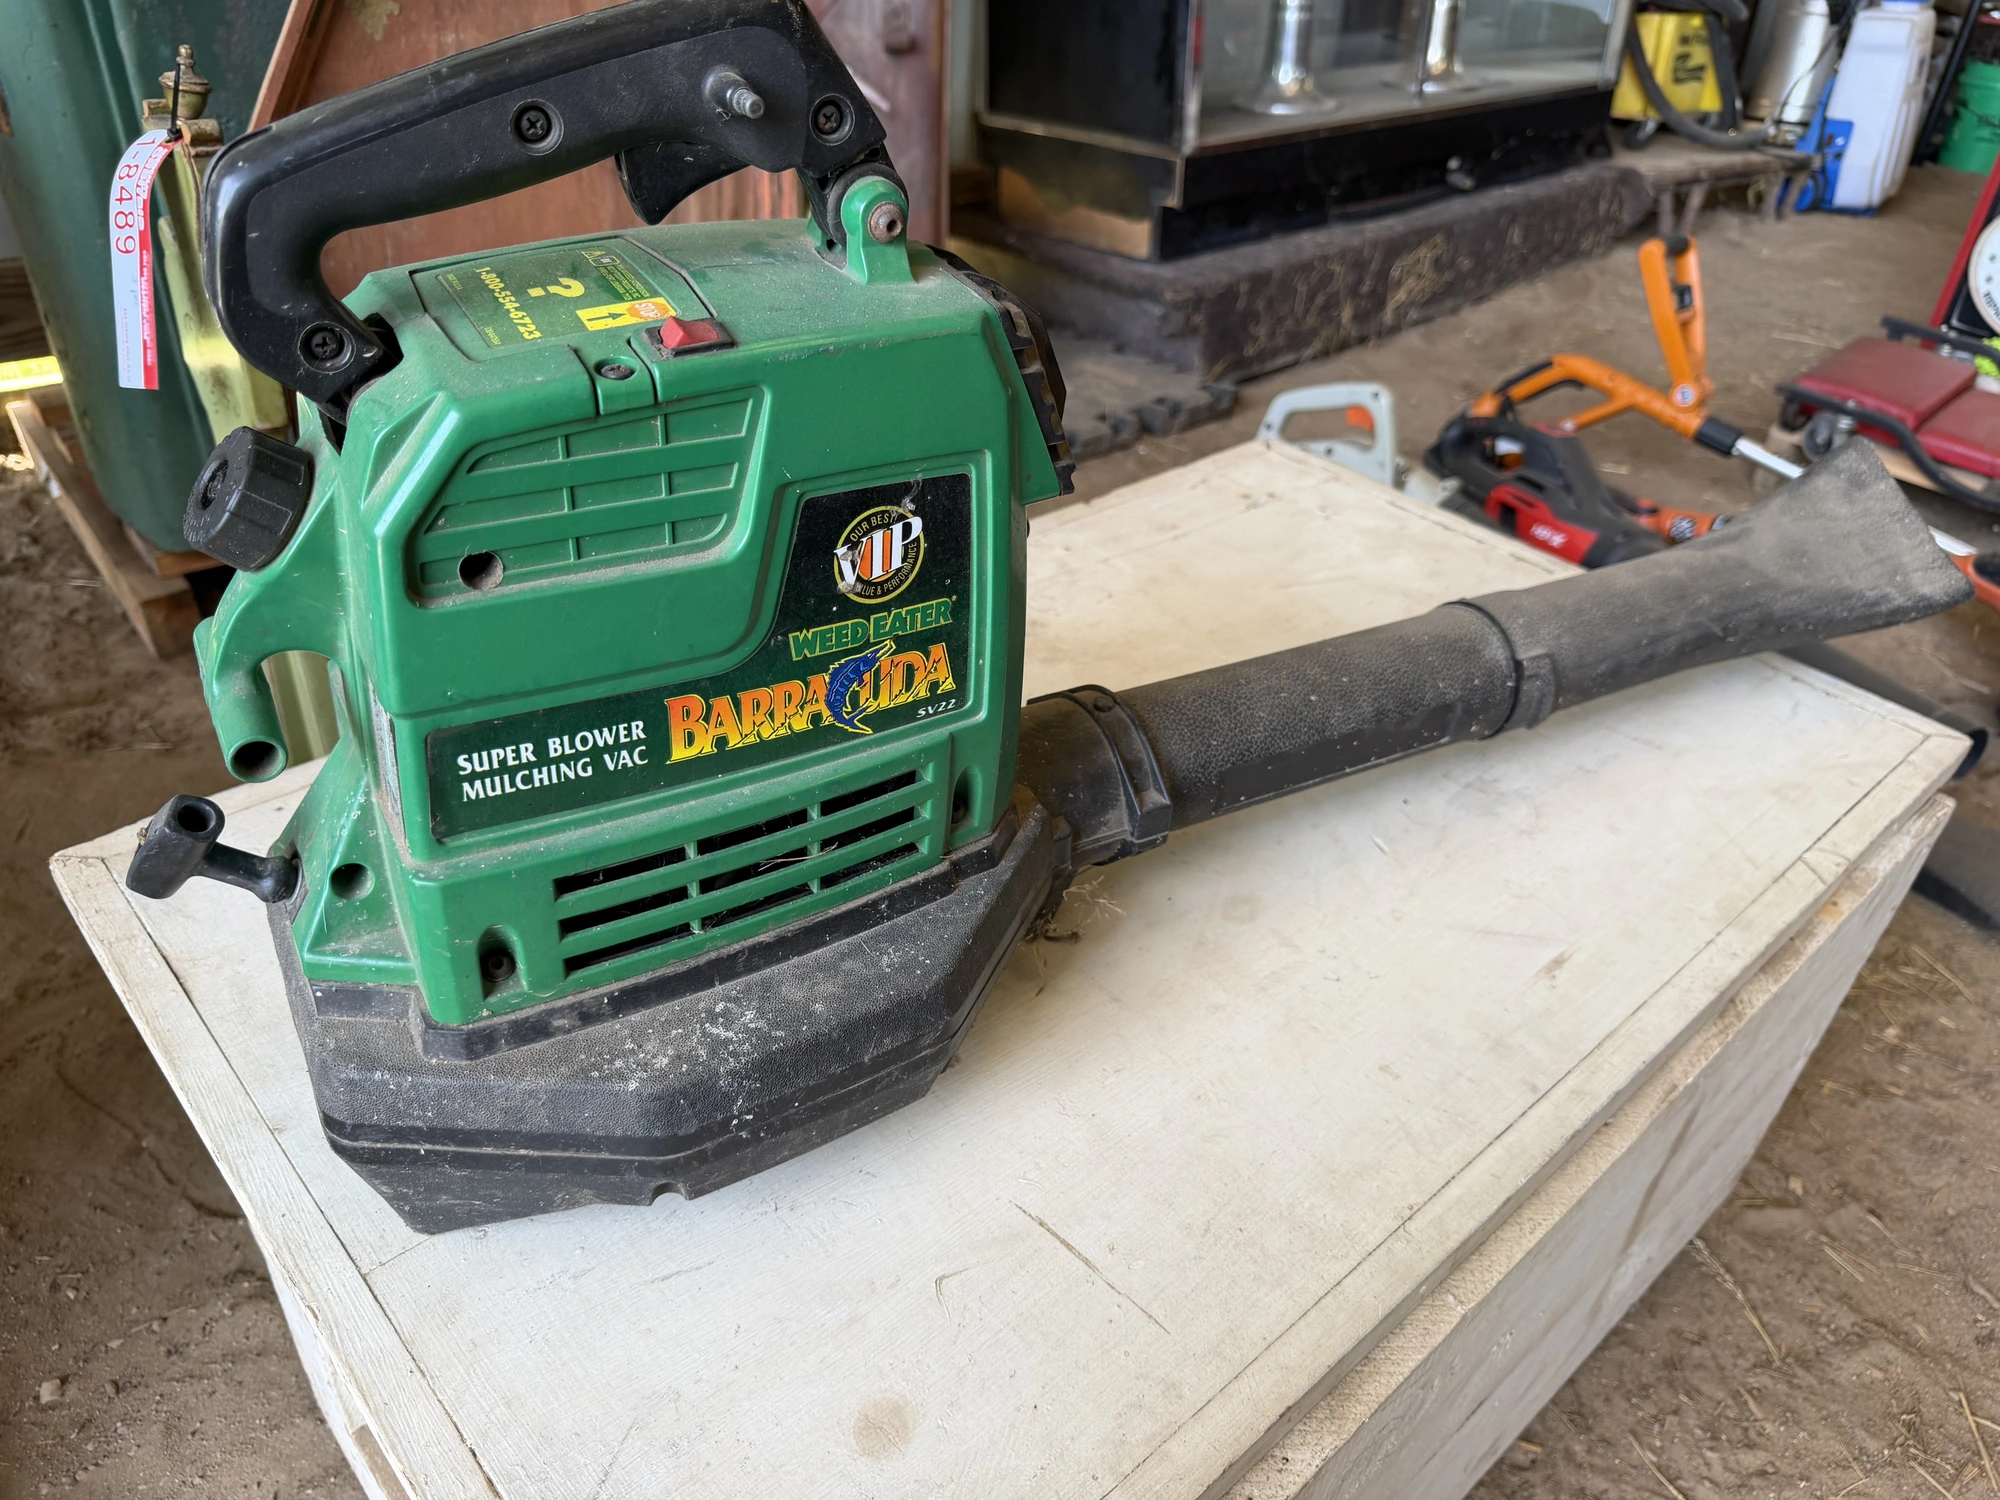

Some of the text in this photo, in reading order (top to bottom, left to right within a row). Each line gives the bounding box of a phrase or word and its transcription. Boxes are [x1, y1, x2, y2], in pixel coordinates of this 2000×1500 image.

[115, 137, 157, 254] 1-8489
[475, 266, 542, 340] 1-800-554-6723
[634, 302, 661, 318] STOP
[833, 516, 923, 585] VIP
[850, 521, 870, 542] OUR
[876, 585, 882, 595] &
[883, 541, 917, 593] PERFORMANCE
[788, 597, 953, 661] WEED EATER
[916, 698, 956, 718] SV22
[457, 720, 647, 775] SUPER BLOWER
[462, 745, 649, 802] MULCHING VAC
